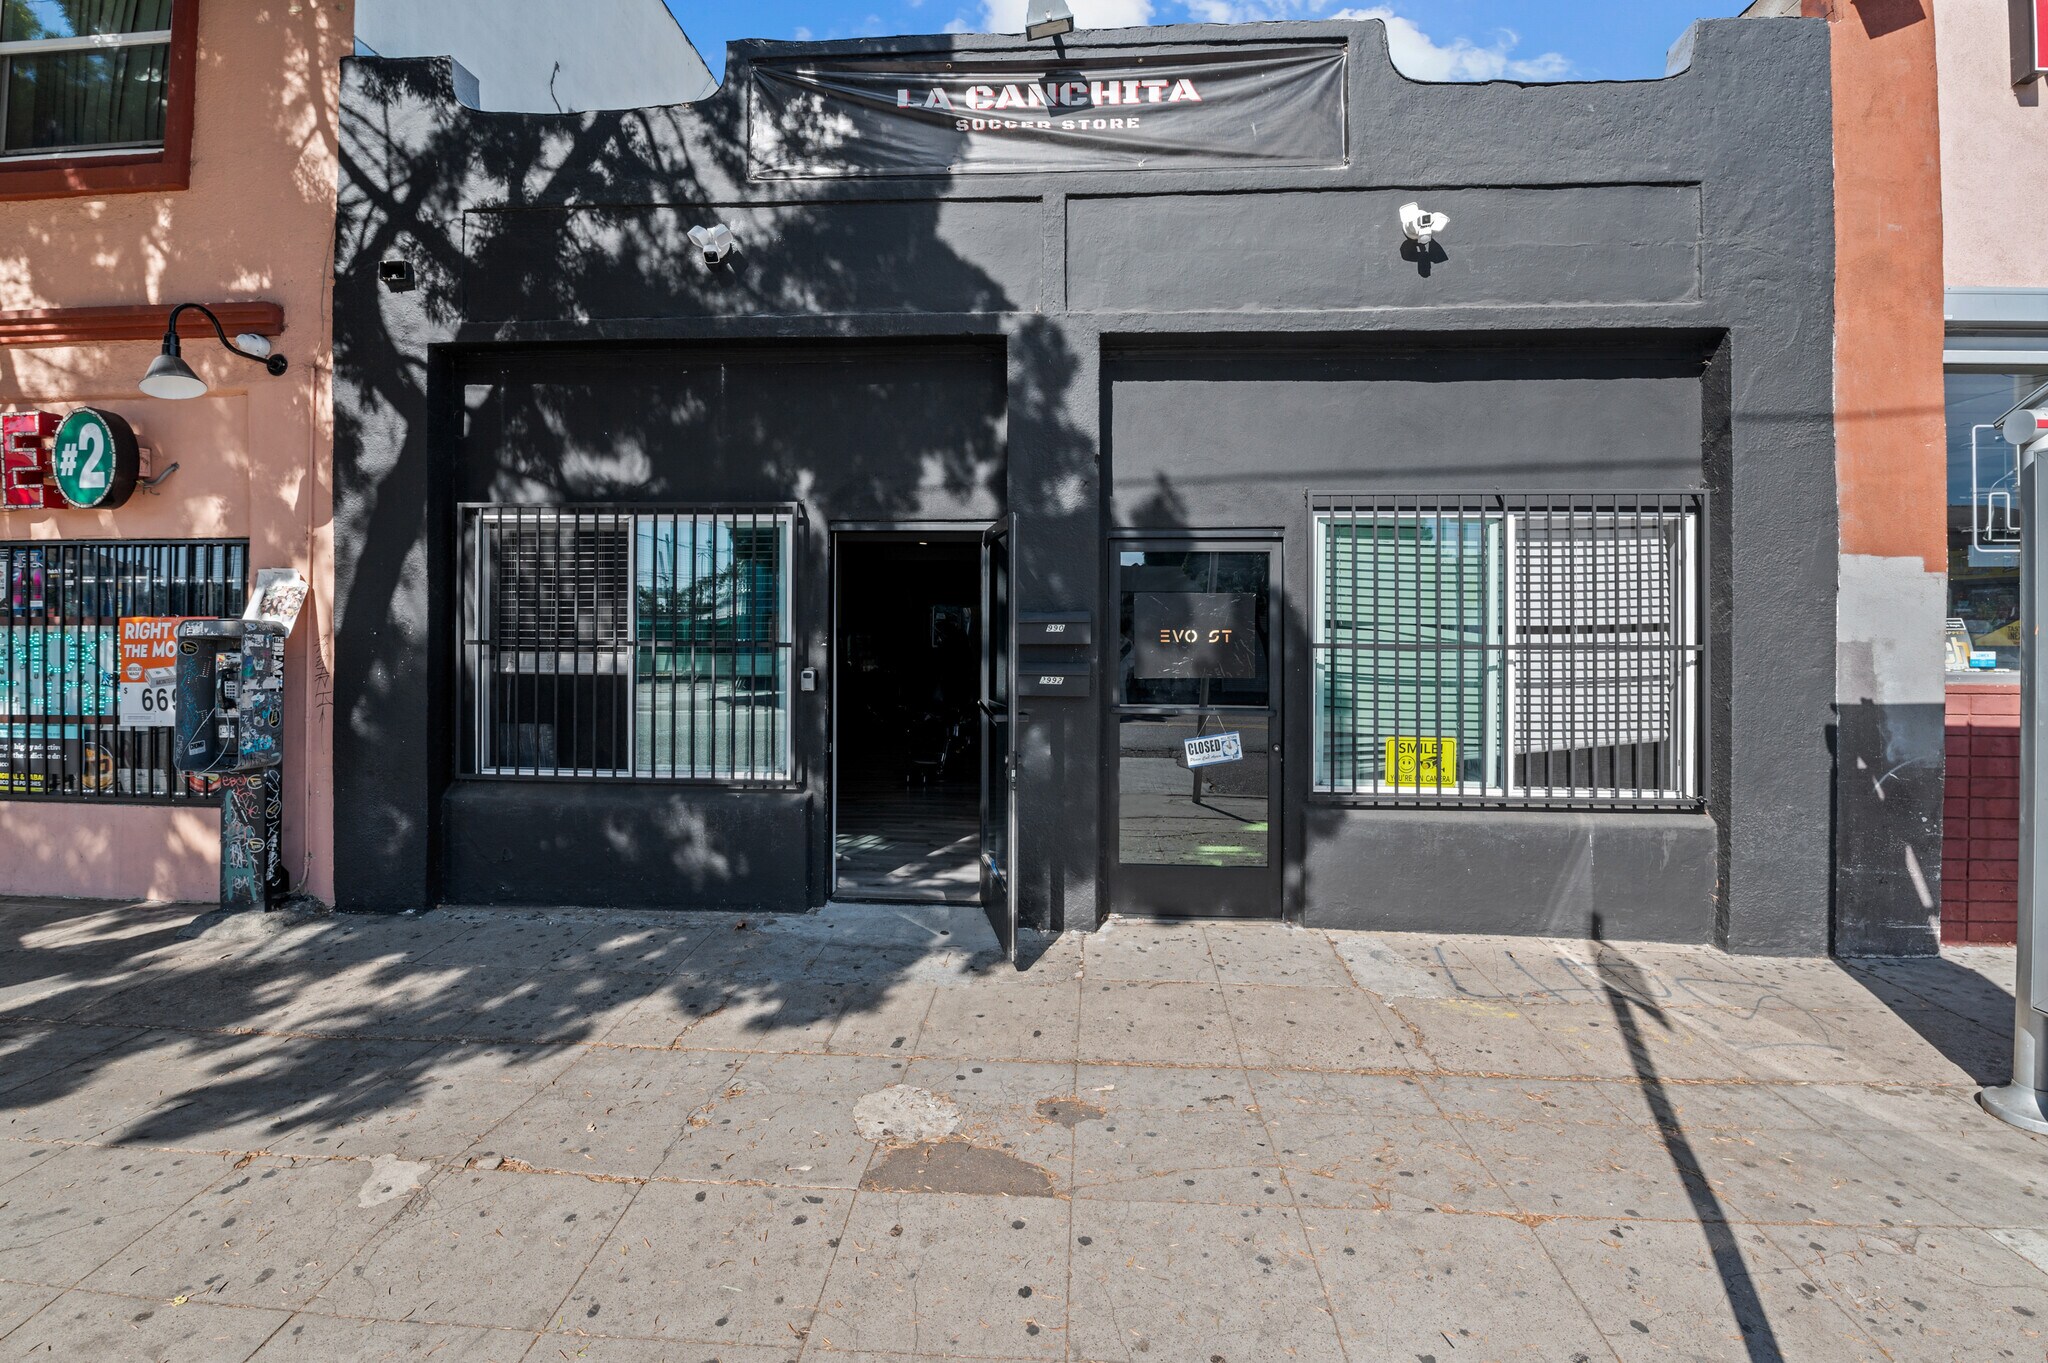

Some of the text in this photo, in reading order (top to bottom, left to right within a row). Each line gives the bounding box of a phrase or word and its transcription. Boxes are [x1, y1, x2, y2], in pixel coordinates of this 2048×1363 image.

[897, 79, 1202, 110] LA CANCHITA
[955, 117, 1140, 132] SOCCER STORE
[60, 422, 105, 489] #2
[125, 622, 172, 640] RIGHT
[1160, 629, 1232, 643] EVO ST
[124, 644, 148, 658] THE
[124, 687, 128, 695] $
[1187, 739, 1221, 755] CLOSED
